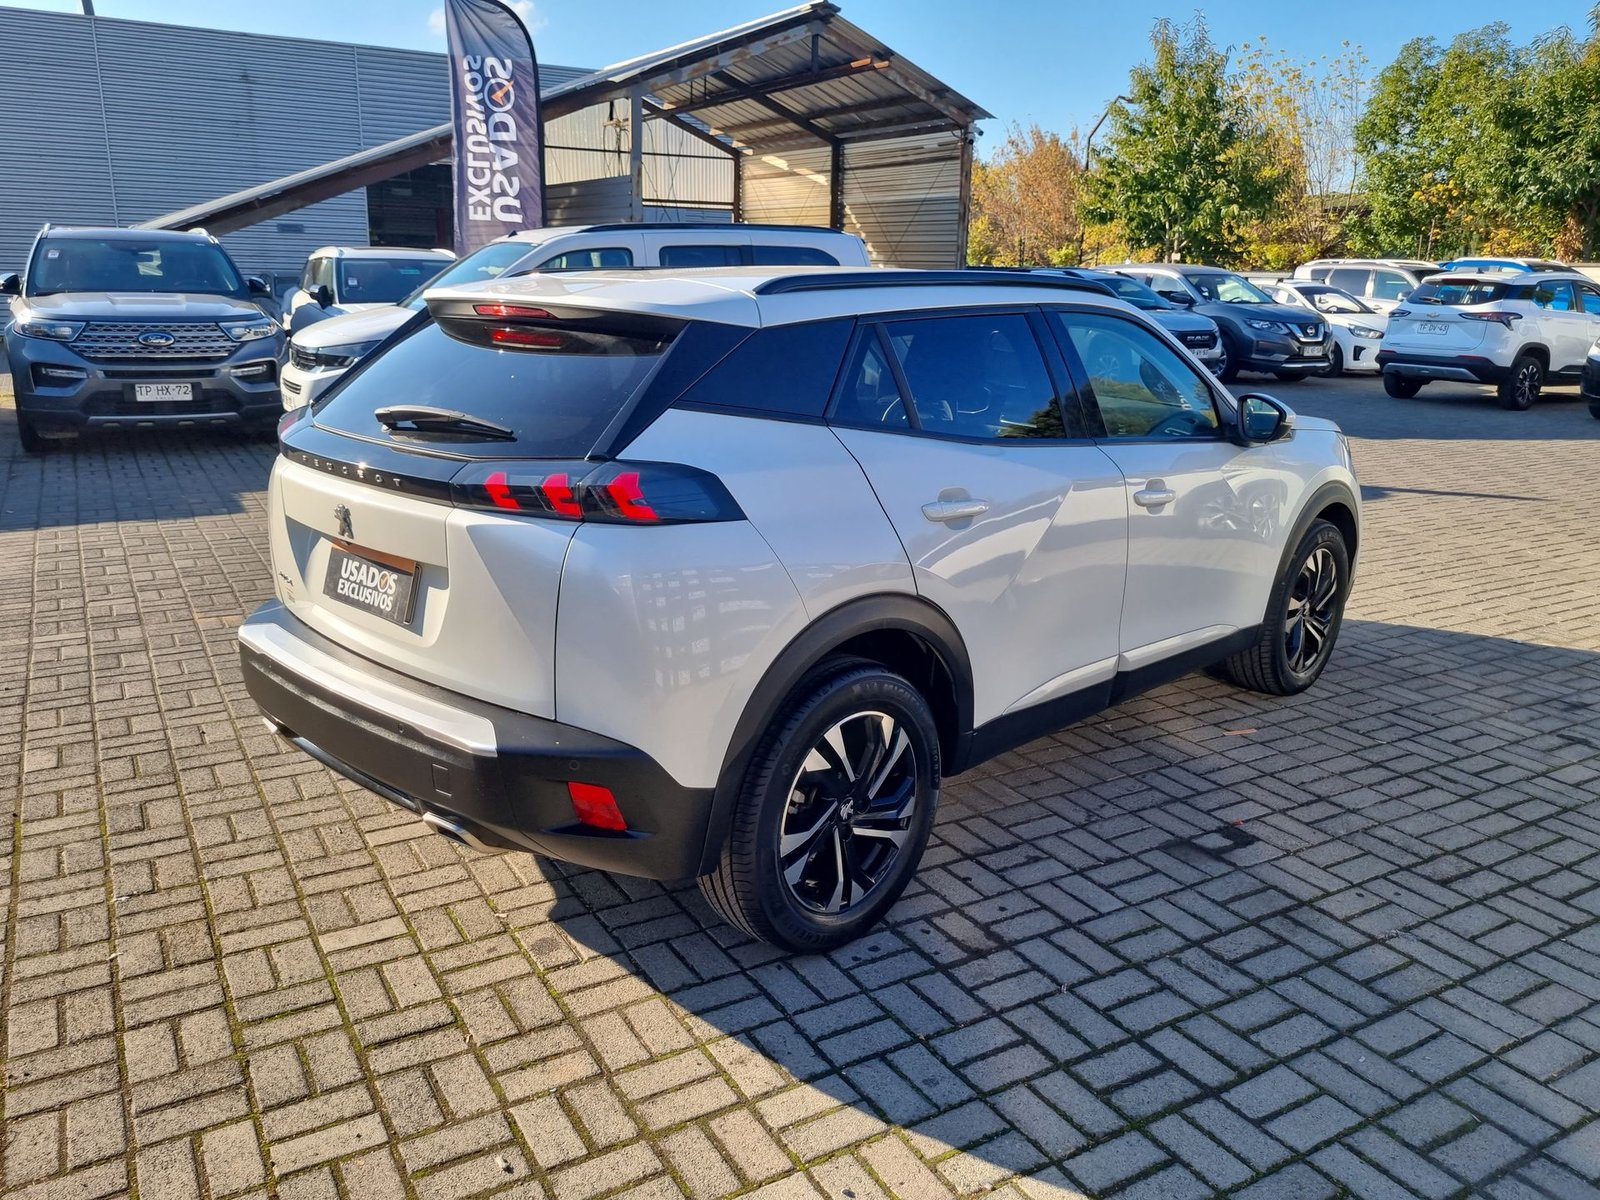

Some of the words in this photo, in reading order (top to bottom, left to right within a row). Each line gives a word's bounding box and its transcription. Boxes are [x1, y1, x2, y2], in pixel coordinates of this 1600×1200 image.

[137, 386, 152, 396] TP
[302, 455, 401, 486] PEUGEOT
[341, 557, 398, 595] USADOS
[337, 579, 393, 611] EXCLUSIVOS
